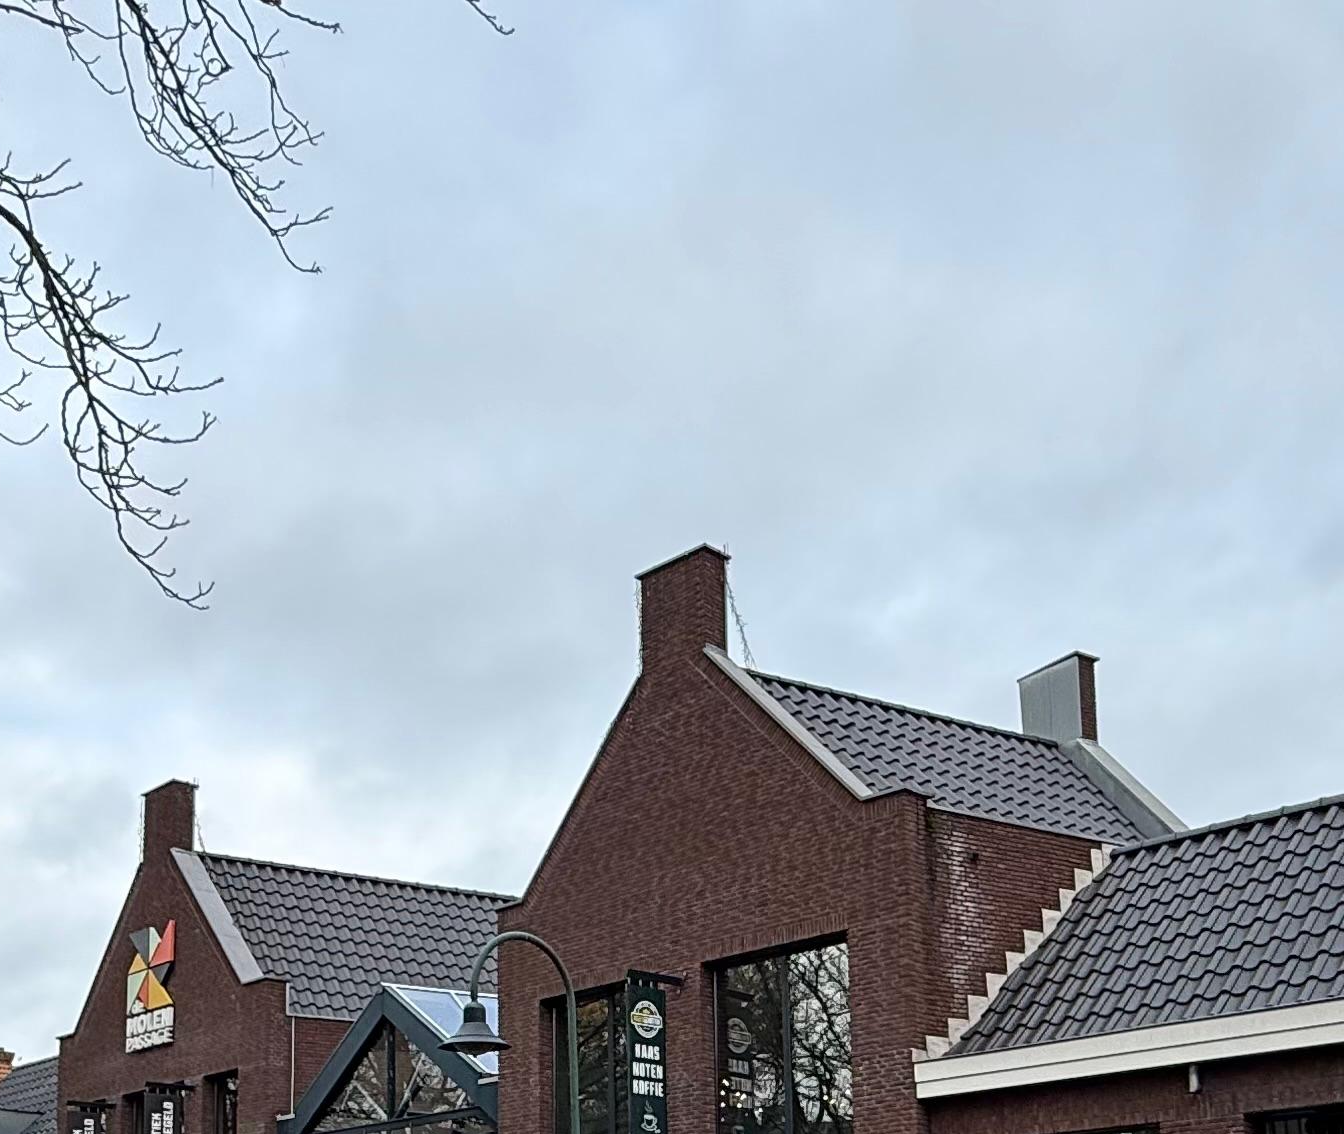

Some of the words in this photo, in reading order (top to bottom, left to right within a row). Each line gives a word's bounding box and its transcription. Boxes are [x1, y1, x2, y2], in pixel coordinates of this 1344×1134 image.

[126, 1027, 174, 1053] PASSAGE
[632, 1061, 664, 1080] NOTEN
[632, 1079, 664, 1098] KOFFIE
